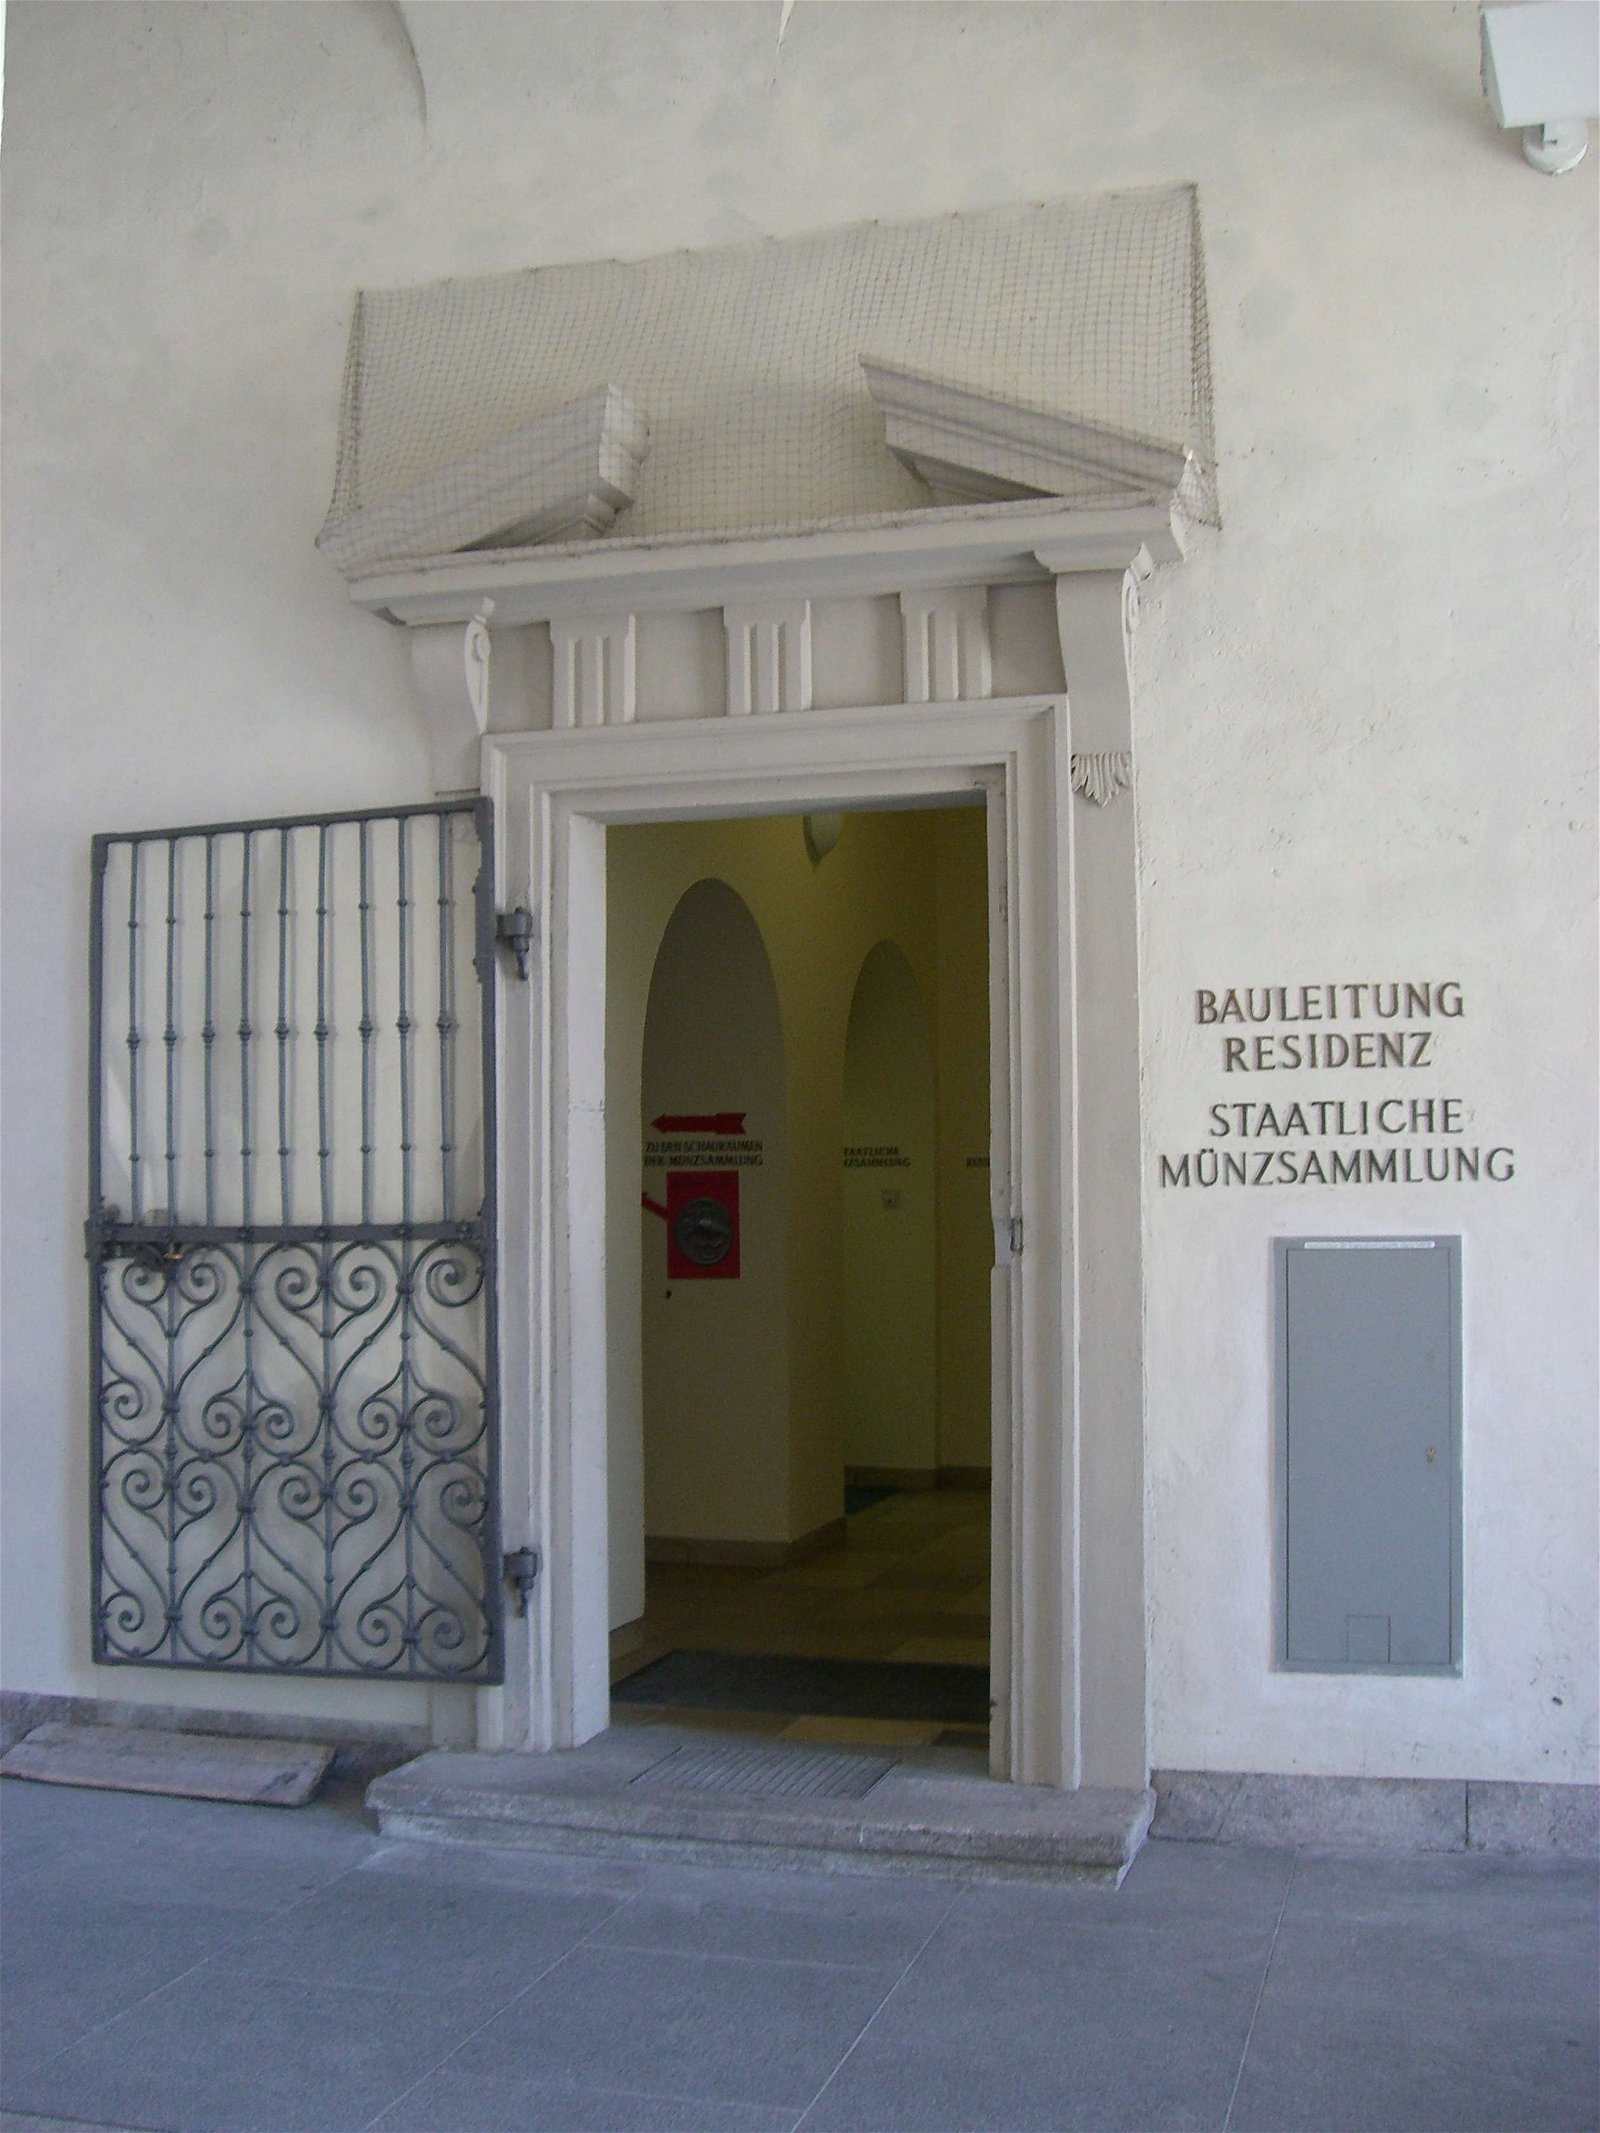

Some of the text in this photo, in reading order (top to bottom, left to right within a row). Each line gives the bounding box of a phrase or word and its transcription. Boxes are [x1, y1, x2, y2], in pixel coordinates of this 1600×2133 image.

[1195, 981, 1465, 1025] BAULEITUNG
[1223, 1031, 1434, 1073] RESIDENZ
[1208, 1098, 1466, 1138] STAATLICHE
[1158, 1147, 1516, 1187] MÜNZSAMMLUNG
